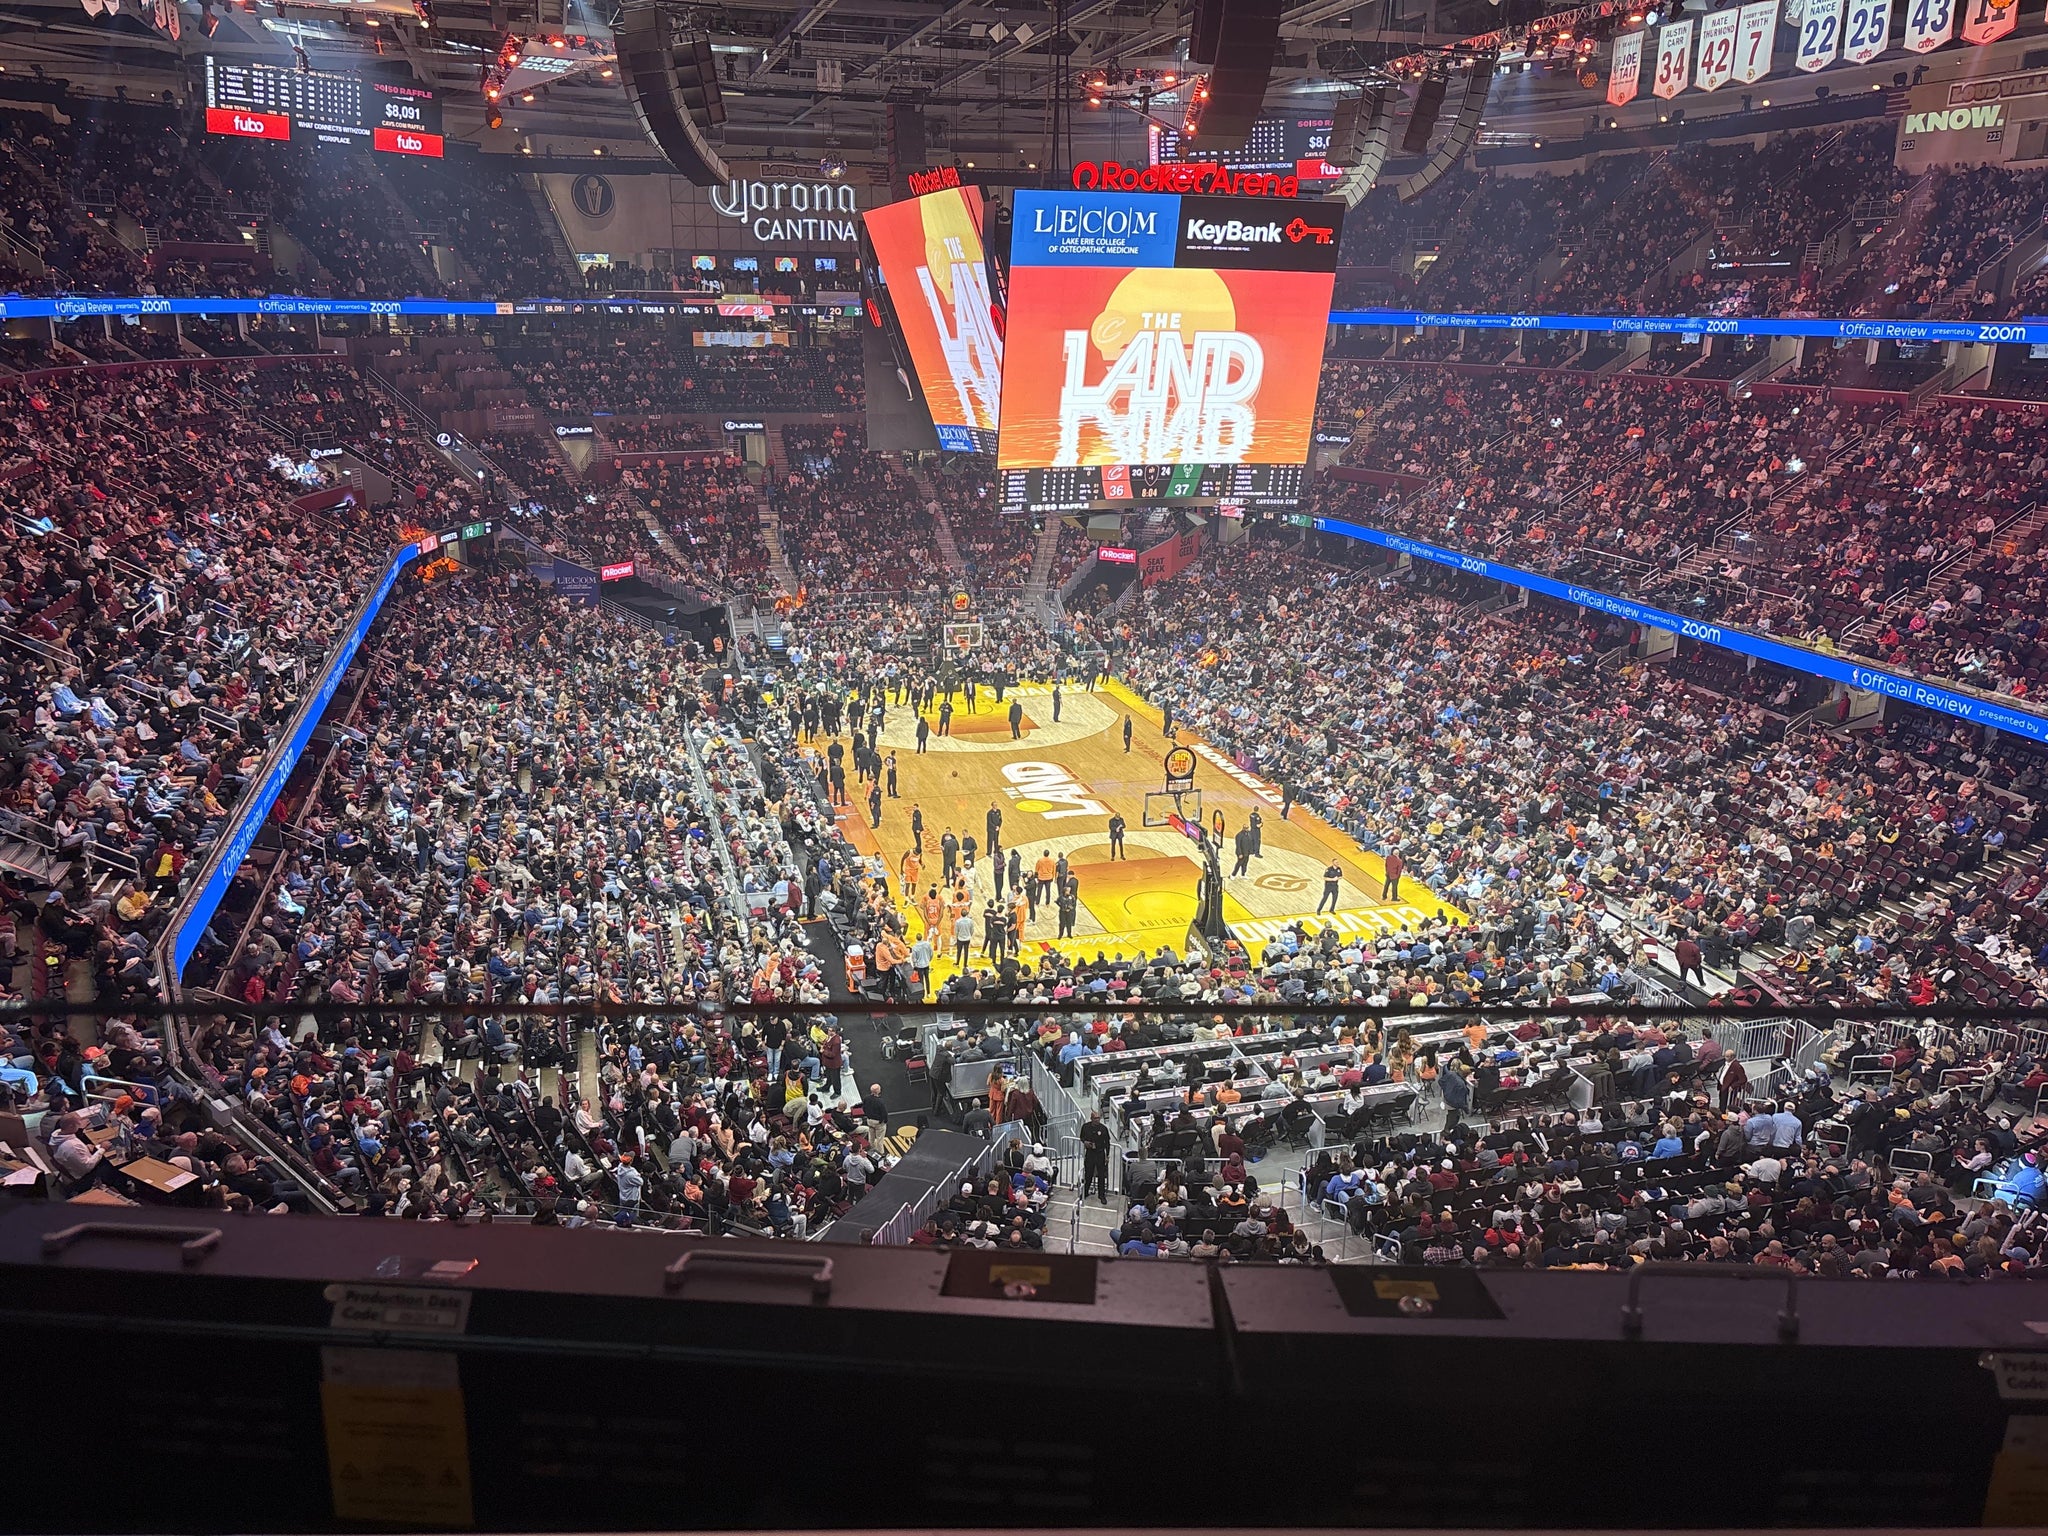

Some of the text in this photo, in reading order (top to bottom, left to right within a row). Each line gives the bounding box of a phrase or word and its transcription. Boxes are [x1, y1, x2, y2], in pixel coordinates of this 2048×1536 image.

[1810, 3, 1836, 16] NANCE
[1711, 16, 1728, 25] NATE
[1746, 18, 1769, 29] SMITH
[1911, 0, 1950, 35] 43
[1665, 26, 1688, 38] AUSTIN
[1703, 24, 1735, 40] THURMOND
[1850, 4, 1887, 48] 25
[1802, 15, 1837, 57] 22
[1667, 37, 1684, 48] CARR
[1748, 31, 1762, 67] 7
[1621, 52, 1637, 67] JOE
[1701, 38, 1731, 75] 42
[1659, 47, 1686, 84] 34
[1619, 65, 1637, 80] TAIT
[399, 88, 433, 99] RAFFLE
[385, 103, 420, 120] $8,091
[233, 115, 264, 133] fubo
[297, 121, 314, 129] WHAT
[314, 123, 342, 133] CONNECTS
[396, 134, 422, 151] fubo
[1987, 132, 2001, 142] 223
[1902, 141, 1915, 150] 222
[1101, 161, 1299, 198] Rocket Arena
[709, 179, 858, 224] Corona
[753, 217, 858, 242] CANTINA
[1187, 218, 1283, 245] KeyBank
[1061, 237, 1126, 246] LAKE ERIE COLLEGE
[943, 237, 965, 260] THE
[1048, 245, 1139, 255] OF OSTEOPATHIC MEDICINE
[60, 301, 87, 313] Official
[88, 301, 113, 312] Review
[141, 300, 171, 312] zoom
[264, 301, 296, 311] Official
[298, 302, 332, 312] Review
[370, 302, 402, 312] zoom
[753, 306, 763, 315] 36
[830, 307, 842, 315] 2Q
[1141, 312, 1182, 328] THE
[1420, 315, 1449, 325] Official
[1450, 316, 1478, 325] Review
[1510, 317, 1540, 327] zoom
[1616, 319, 1643, 330] Official
[1644, 320, 1673, 330] Review
[1706, 320, 1739, 332] zoom
[1845, 323, 2026, 341] Official Review presented by zoom
[1062, 329, 1265, 398] LAND
[501, 413, 536, 421] LITEHOUSE
[566, 426, 593, 434] LEXUS
[736, 422, 764, 430] LEXUS
[320, 448, 343, 456] LEXUS
[1161, 466, 1171, 476] 24
[1109, 485, 1124, 497] 36
[1141, 488, 1158, 497] 8:04
[1174, 484, 1190, 495] 37
[1058, 502, 1090, 510] RAFFLE
[1291, 515, 1300, 524] 37
[465, 527, 474, 537] 12
[1180, 536, 1194, 547] SEAT
[1108, 551, 1134, 560] Rocket
[1179, 545, 1194, 557] GEEK
[1389, 536, 1411, 551] Official
[1411, 543, 1434, 558] Review
[1460, 556, 1487, 573] zoom
[1147, 557, 1165, 566] SEAT
[609, 565, 632, 577] Rocket
[1146, 564, 1165, 573] GEEK
[1573, 590, 1721, 643] Official Review presented by zoom
[1860, 672, 2040, 734] Official Review presented by
[1001, 761, 1117, 820] LAND
[227, 747, 294, 877] Official Review zoom
[928, 906, 938, 914] 31
[1139, 916, 1187, 928] EDITION
[1229, 906, 1430, 943] CLEVELAND
[345, 1289, 462, 1309] Production Date
[341, 1307, 379, 1322] Code
